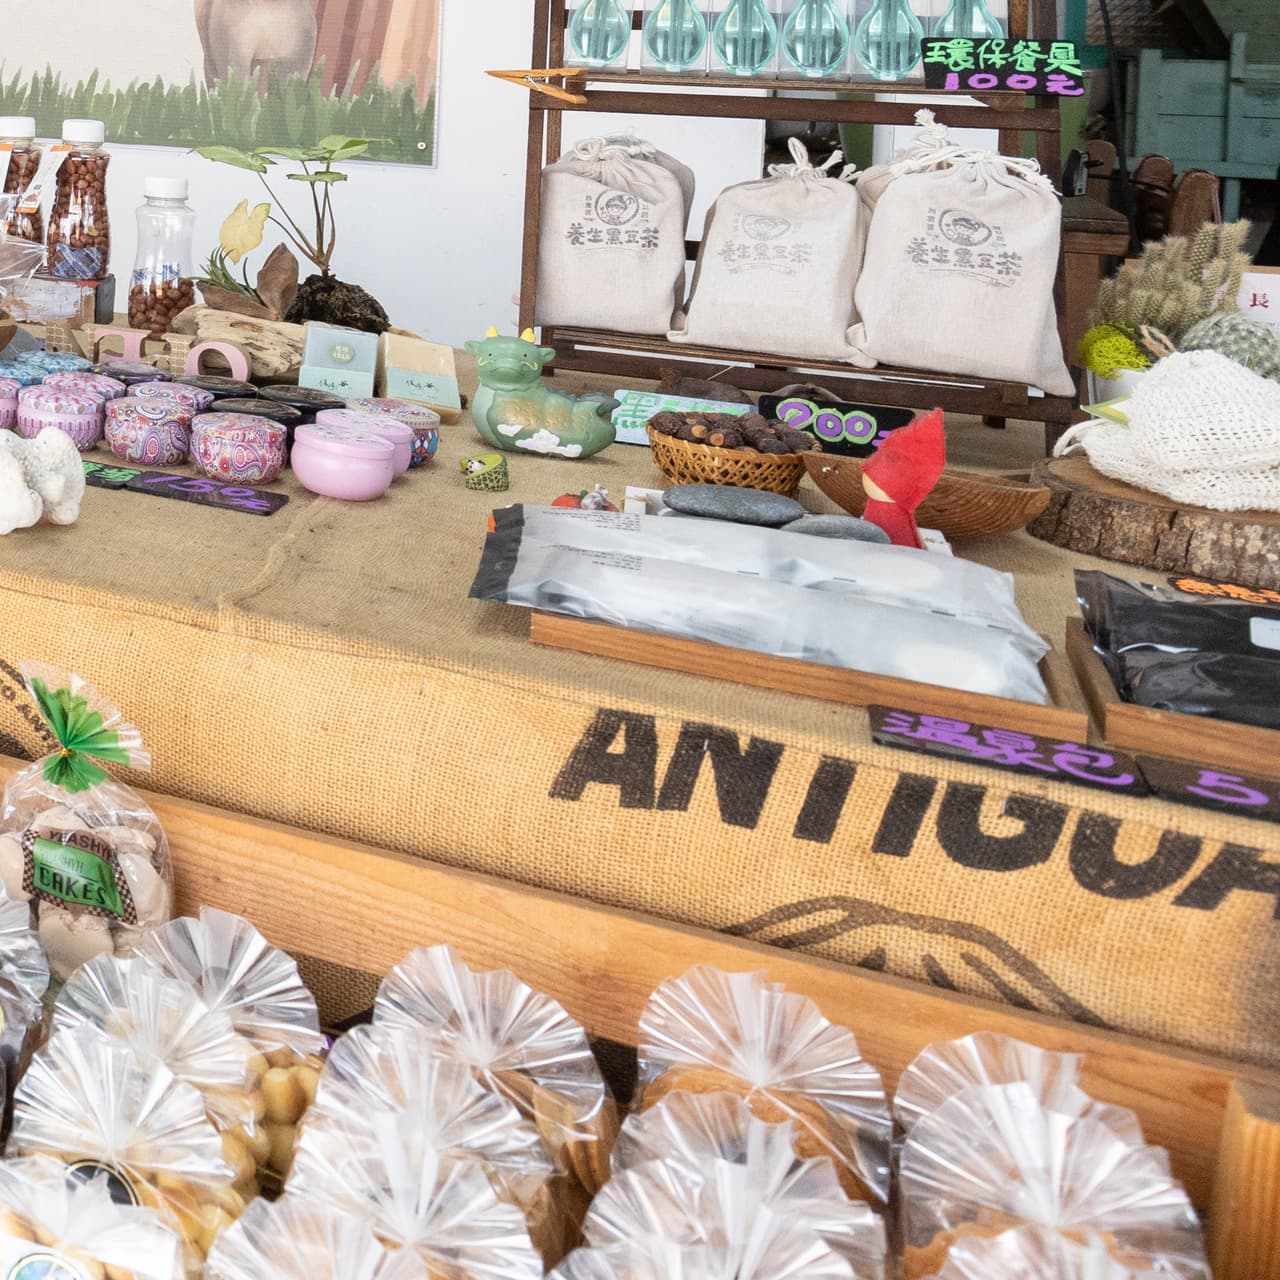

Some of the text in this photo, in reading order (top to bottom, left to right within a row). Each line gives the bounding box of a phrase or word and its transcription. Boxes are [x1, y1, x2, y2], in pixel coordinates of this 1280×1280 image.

[924, 40, 1084, 76] 環保餐具
[944, 73, 1085, 98] 100元
[567, 222, 660, 249] 養生黑豆茶
[718, 240, 813, 264] 養生黑豆茶
[906, 237, 1023, 277] 養生黑豆茶
[1250, 292, 1270, 310] 長
[881, 710, 1135, 787] 溫泉包
[39, 866, 106, 904] CAKES
